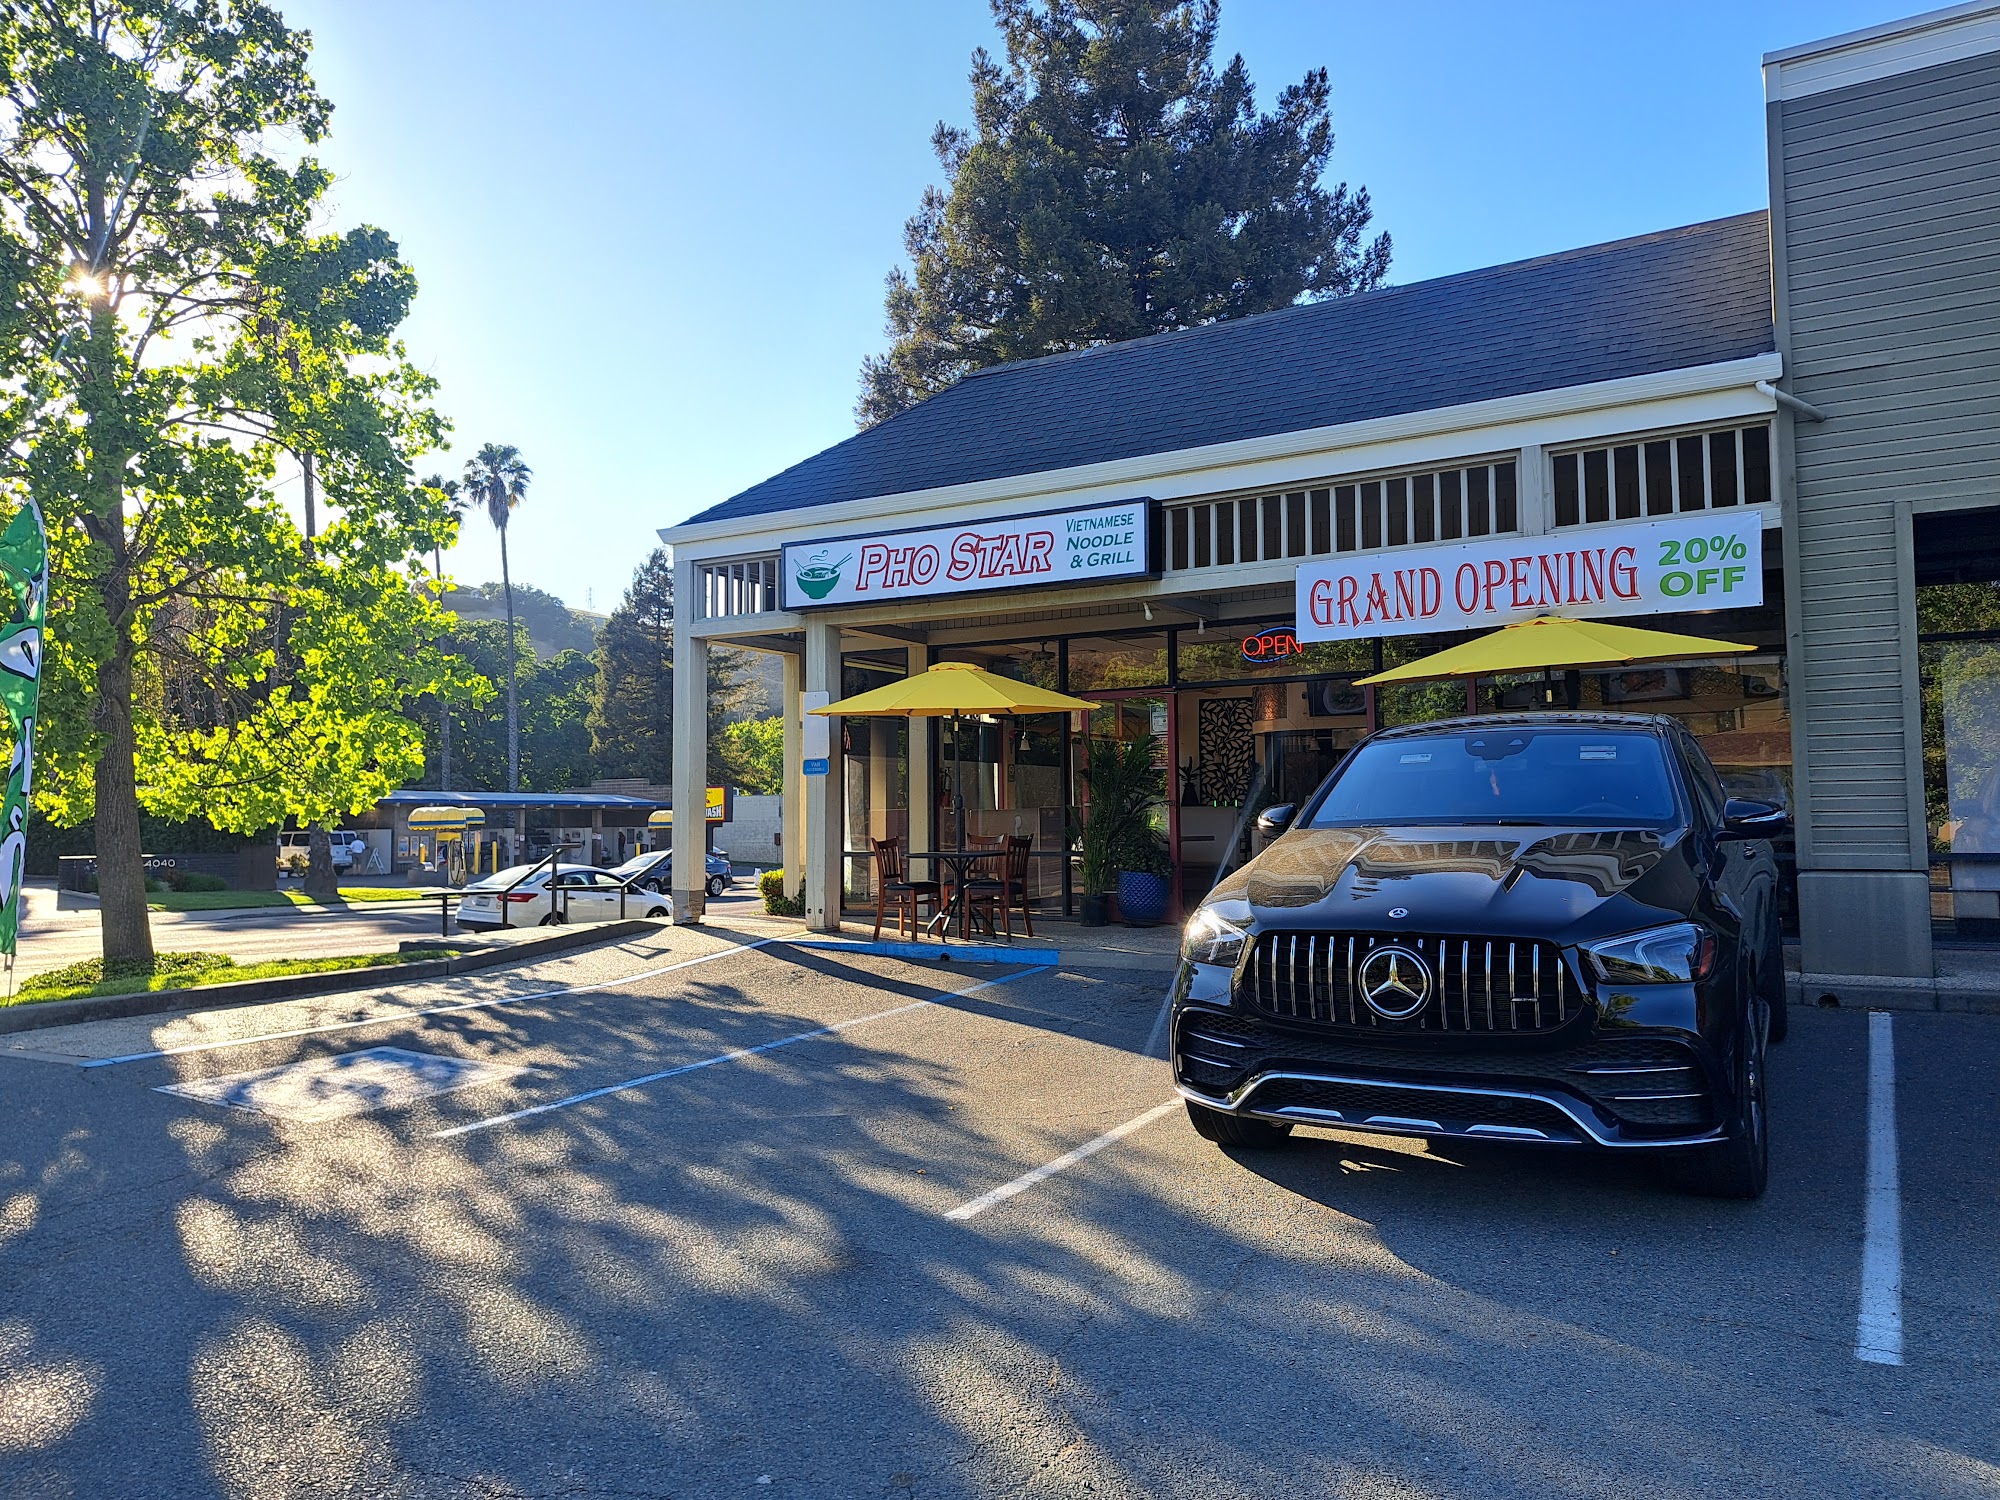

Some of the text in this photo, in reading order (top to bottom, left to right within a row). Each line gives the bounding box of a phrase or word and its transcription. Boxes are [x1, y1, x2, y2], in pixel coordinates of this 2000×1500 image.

[1066, 513, 1134, 533] VIETNAMESE
[1066, 531, 1134, 551] NOODLE
[1658, 534, 1747, 566] 20%
[855, 532, 1054, 591] PHO STAR
[1070, 551, 1134, 569] & GRILL
[1309, 546, 1642, 630] GRAND OPENING
[1659, 566, 1746, 597] OFF
[1242, 635, 1304, 656] OPEN
[143, 858, 176, 868] 4040
